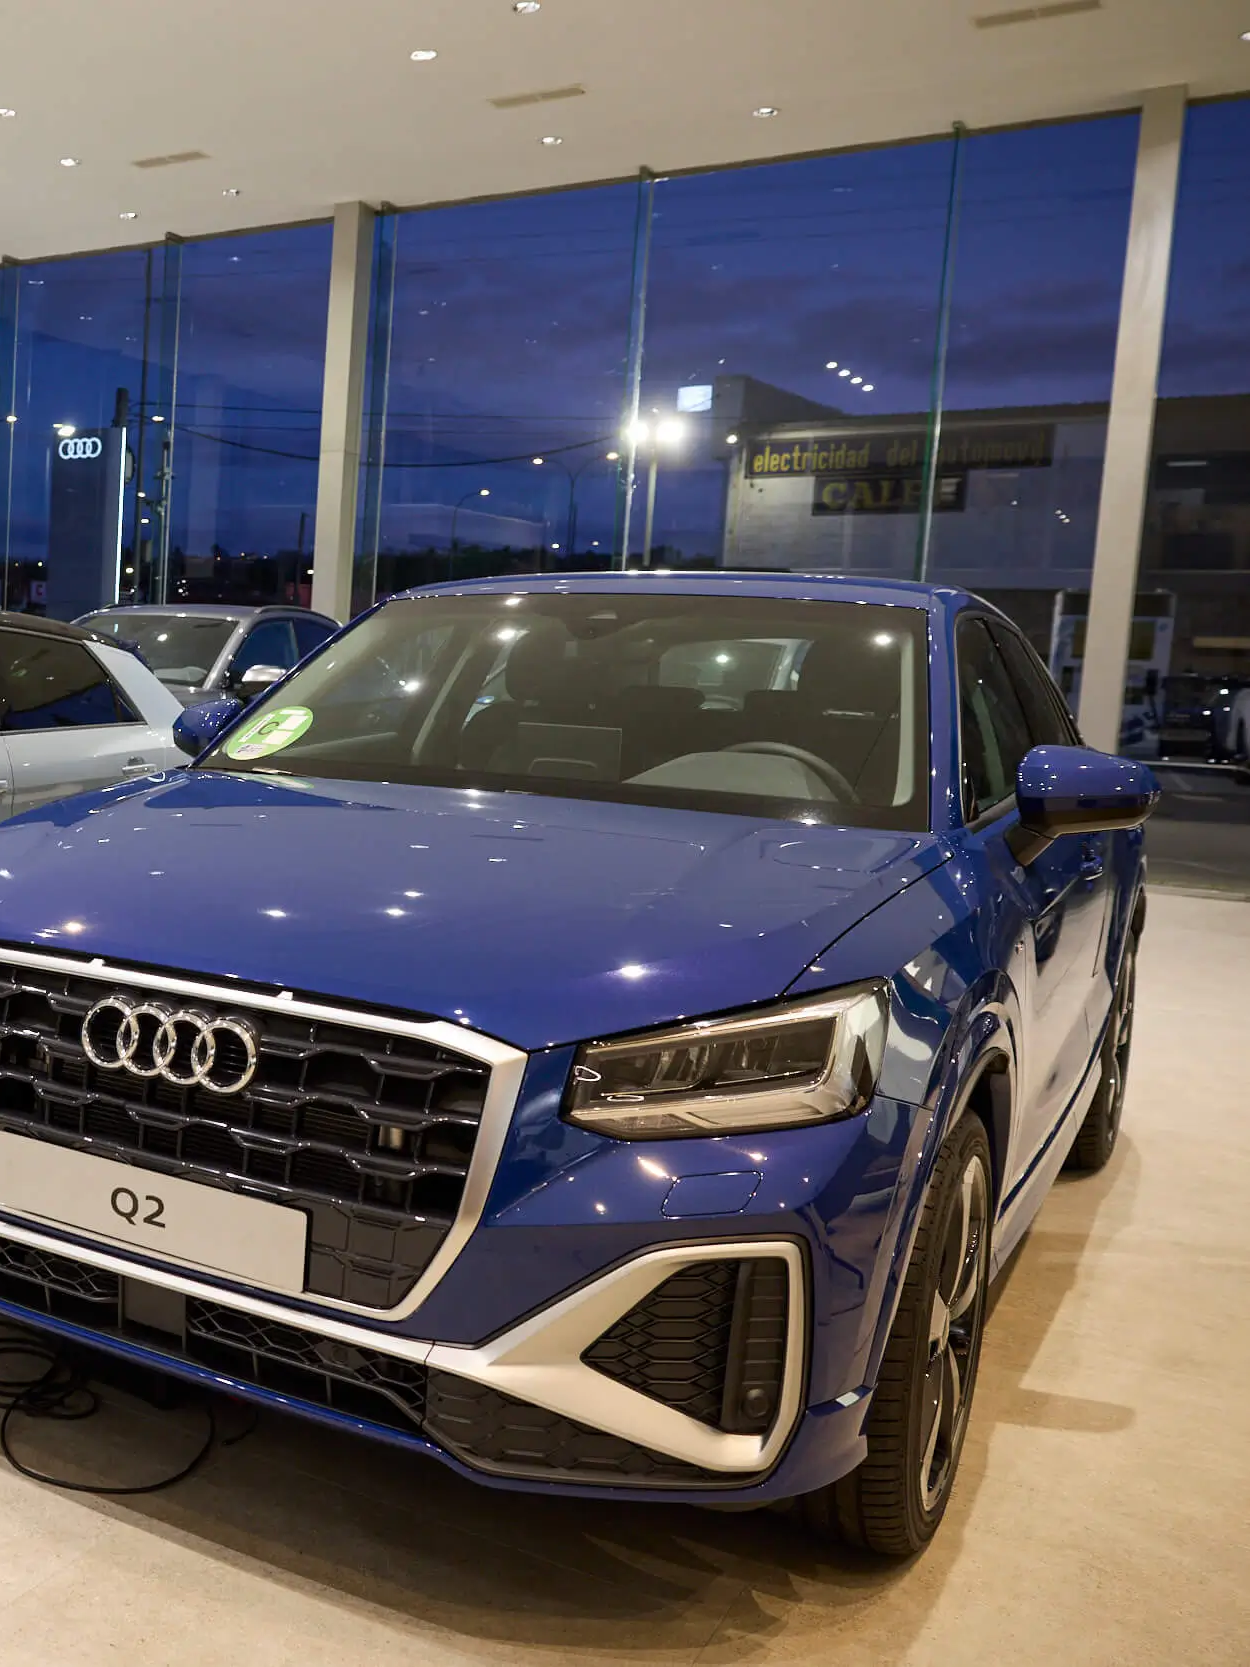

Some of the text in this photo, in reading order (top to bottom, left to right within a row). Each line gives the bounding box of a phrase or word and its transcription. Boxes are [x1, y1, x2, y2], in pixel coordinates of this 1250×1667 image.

[753, 441, 870, 473] electricidad
[886, 439, 918, 467] del
[258, 721, 280, 735] C
[110, 1186, 166, 1229] Q2
